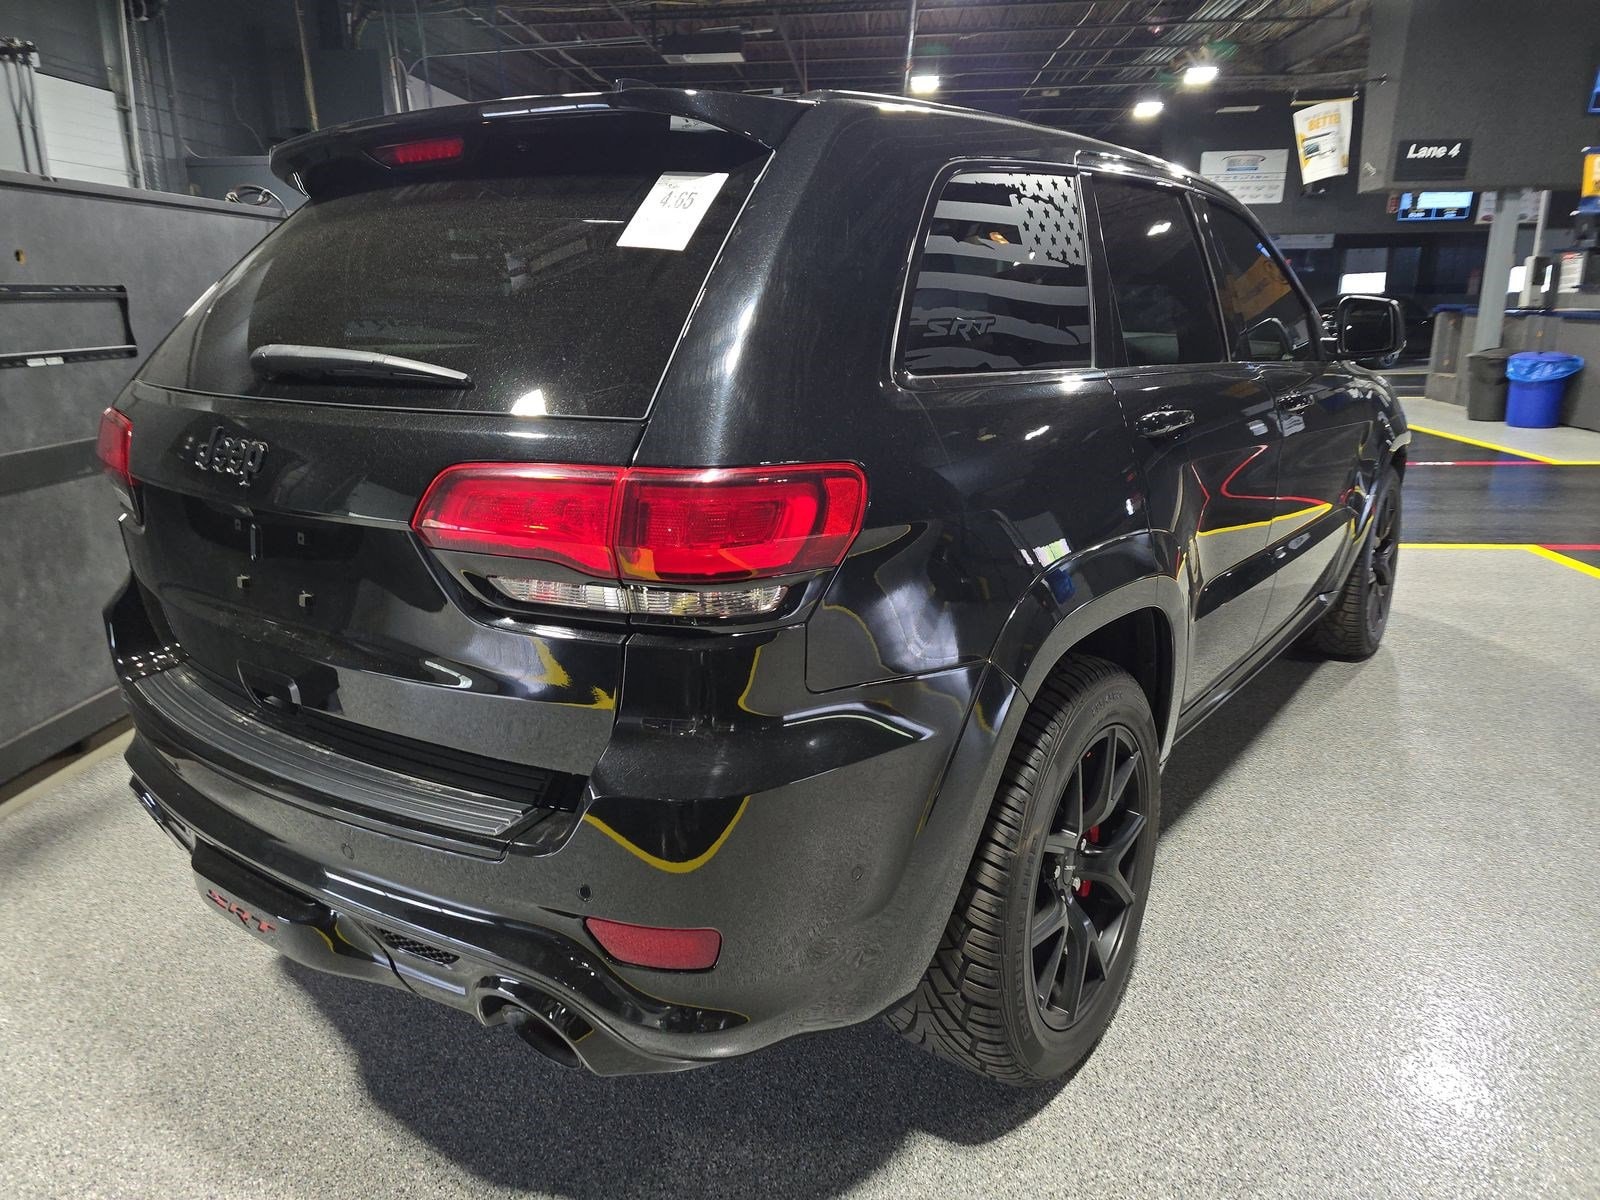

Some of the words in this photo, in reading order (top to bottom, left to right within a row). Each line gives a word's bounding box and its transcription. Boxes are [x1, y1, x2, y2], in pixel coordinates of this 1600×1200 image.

[1406, 143, 1447, 158] Lane
[1448, 143, 1462, 158] 4
[923, 316, 996, 341] SRT
[194, 425, 269, 487] Jeep
[206, 889, 276, 933] SRT
